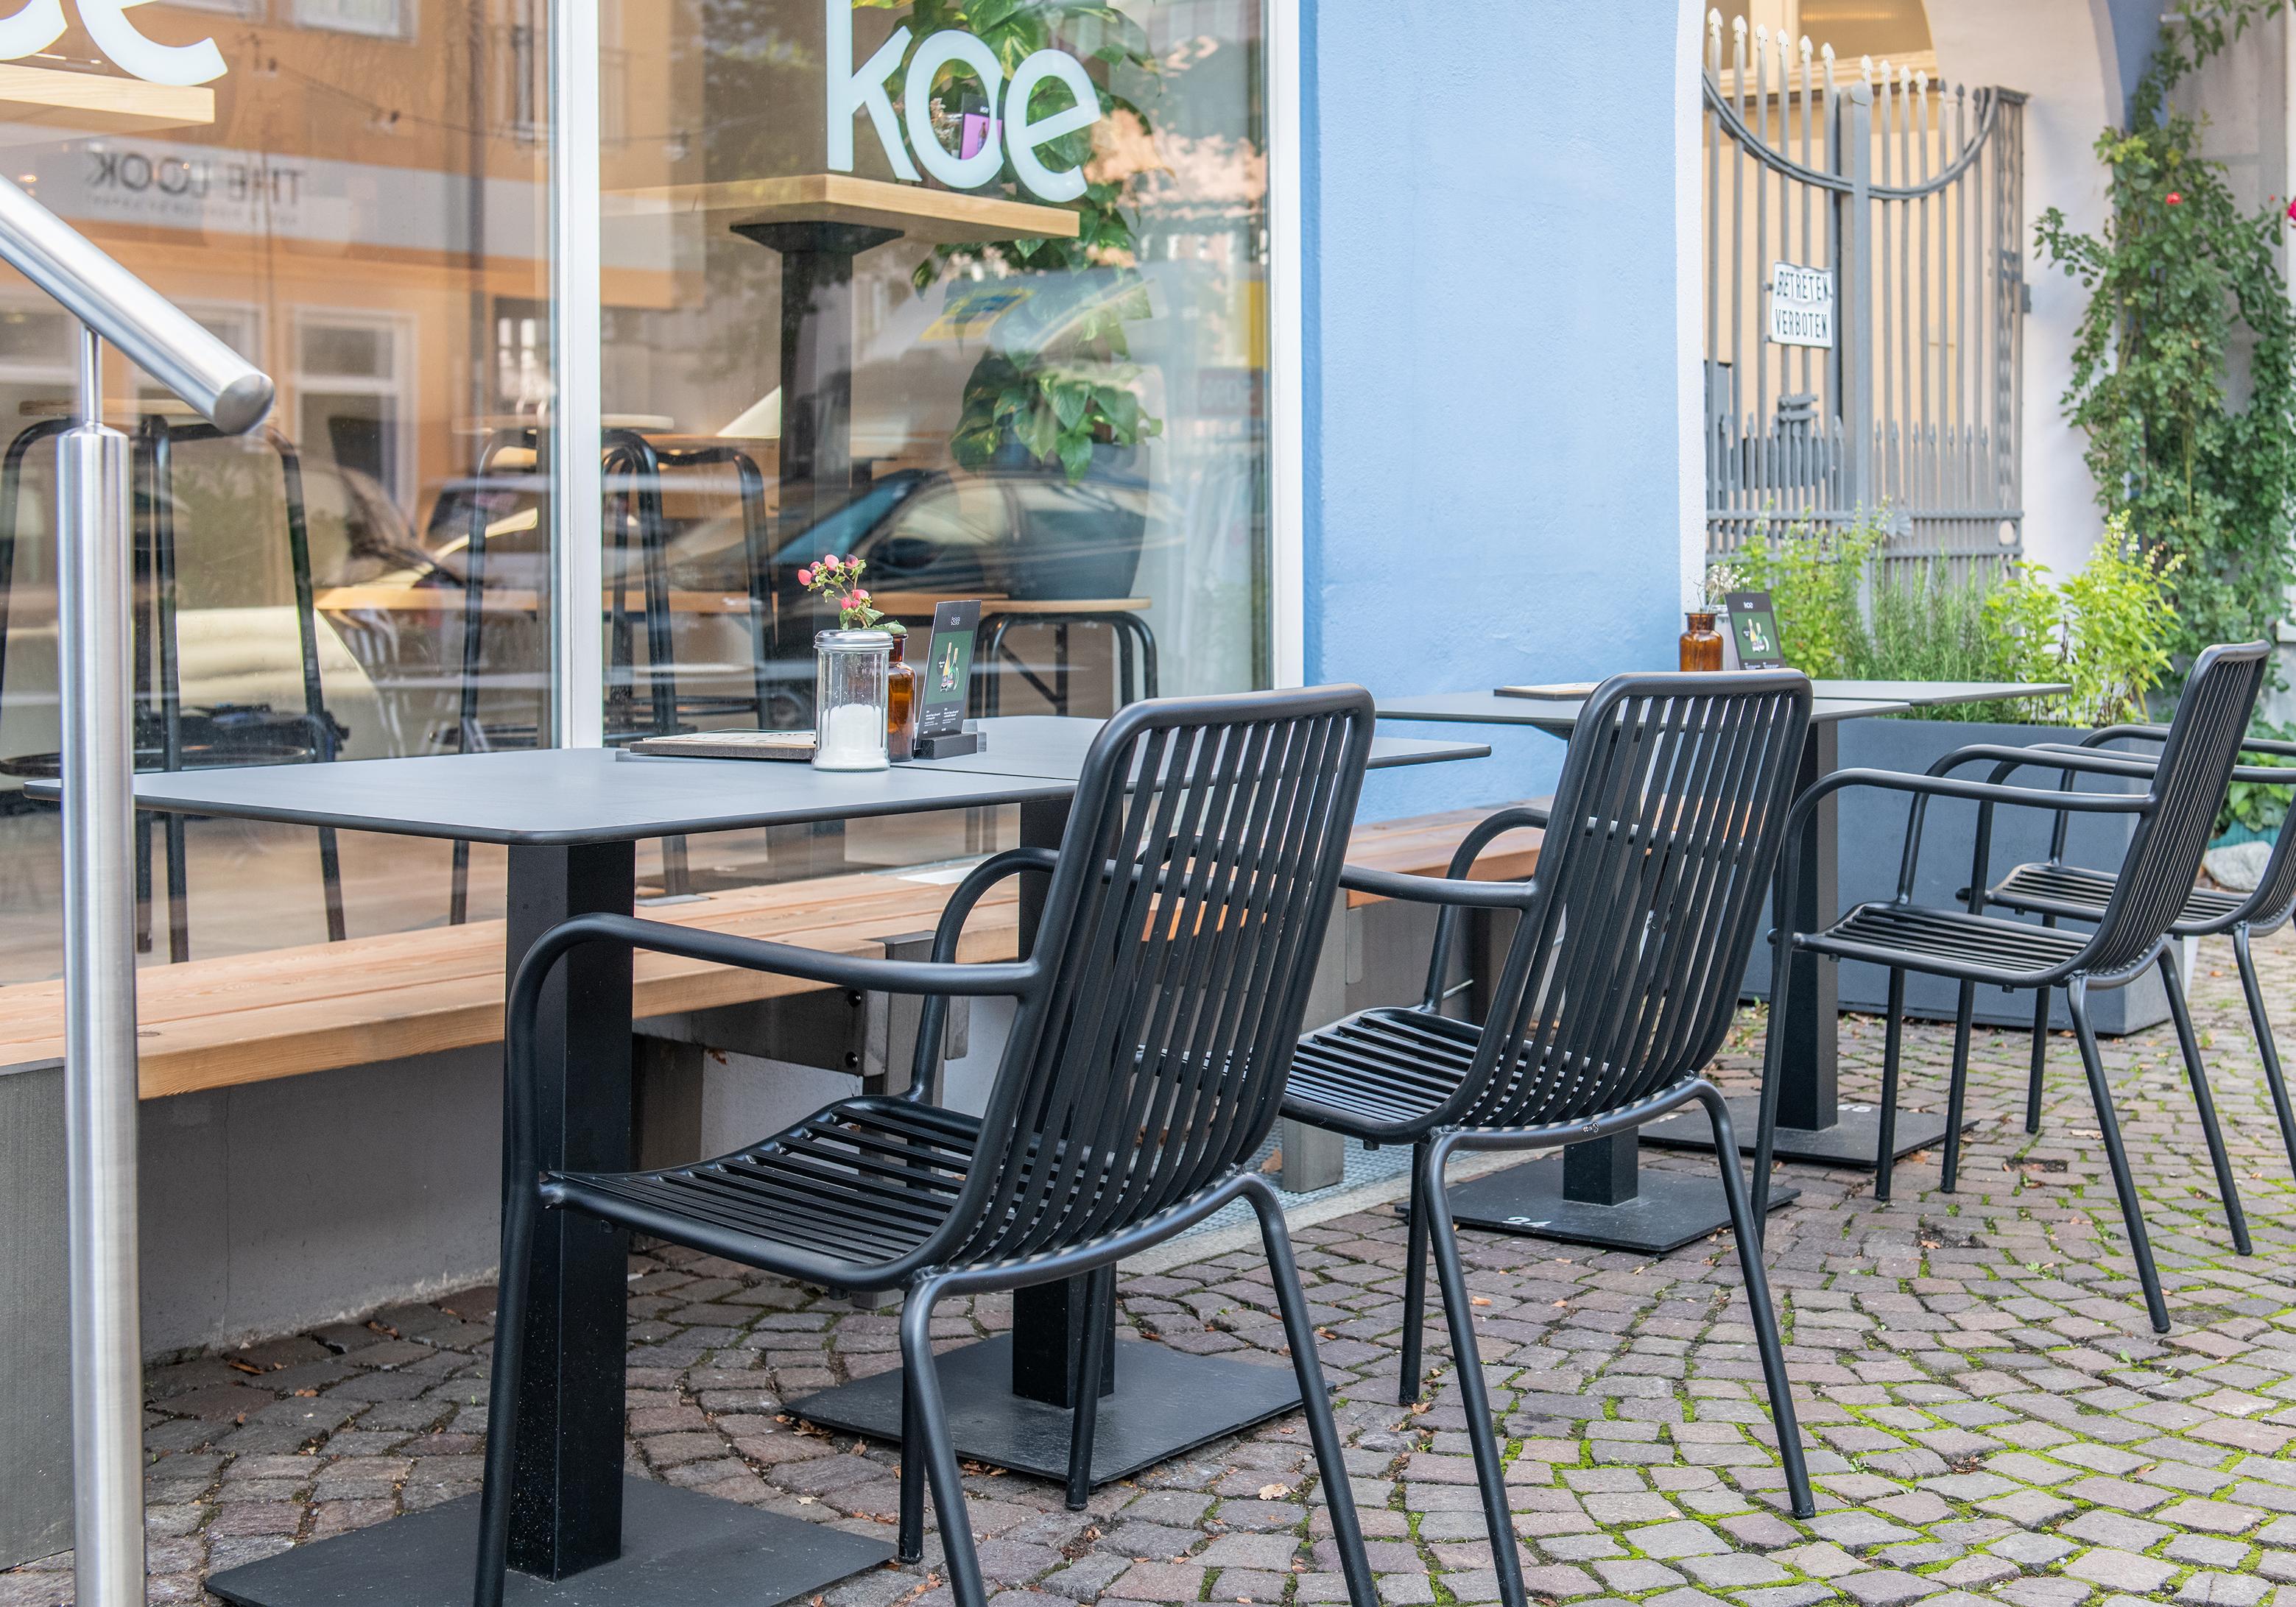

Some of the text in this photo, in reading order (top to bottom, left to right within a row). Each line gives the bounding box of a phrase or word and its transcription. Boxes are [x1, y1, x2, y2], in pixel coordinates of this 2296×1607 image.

[826, 0, 1101, 202] koe
[1777, 271, 1828, 300] BETRETEN
[1775, 308, 1828, 339] VERBOTEN
